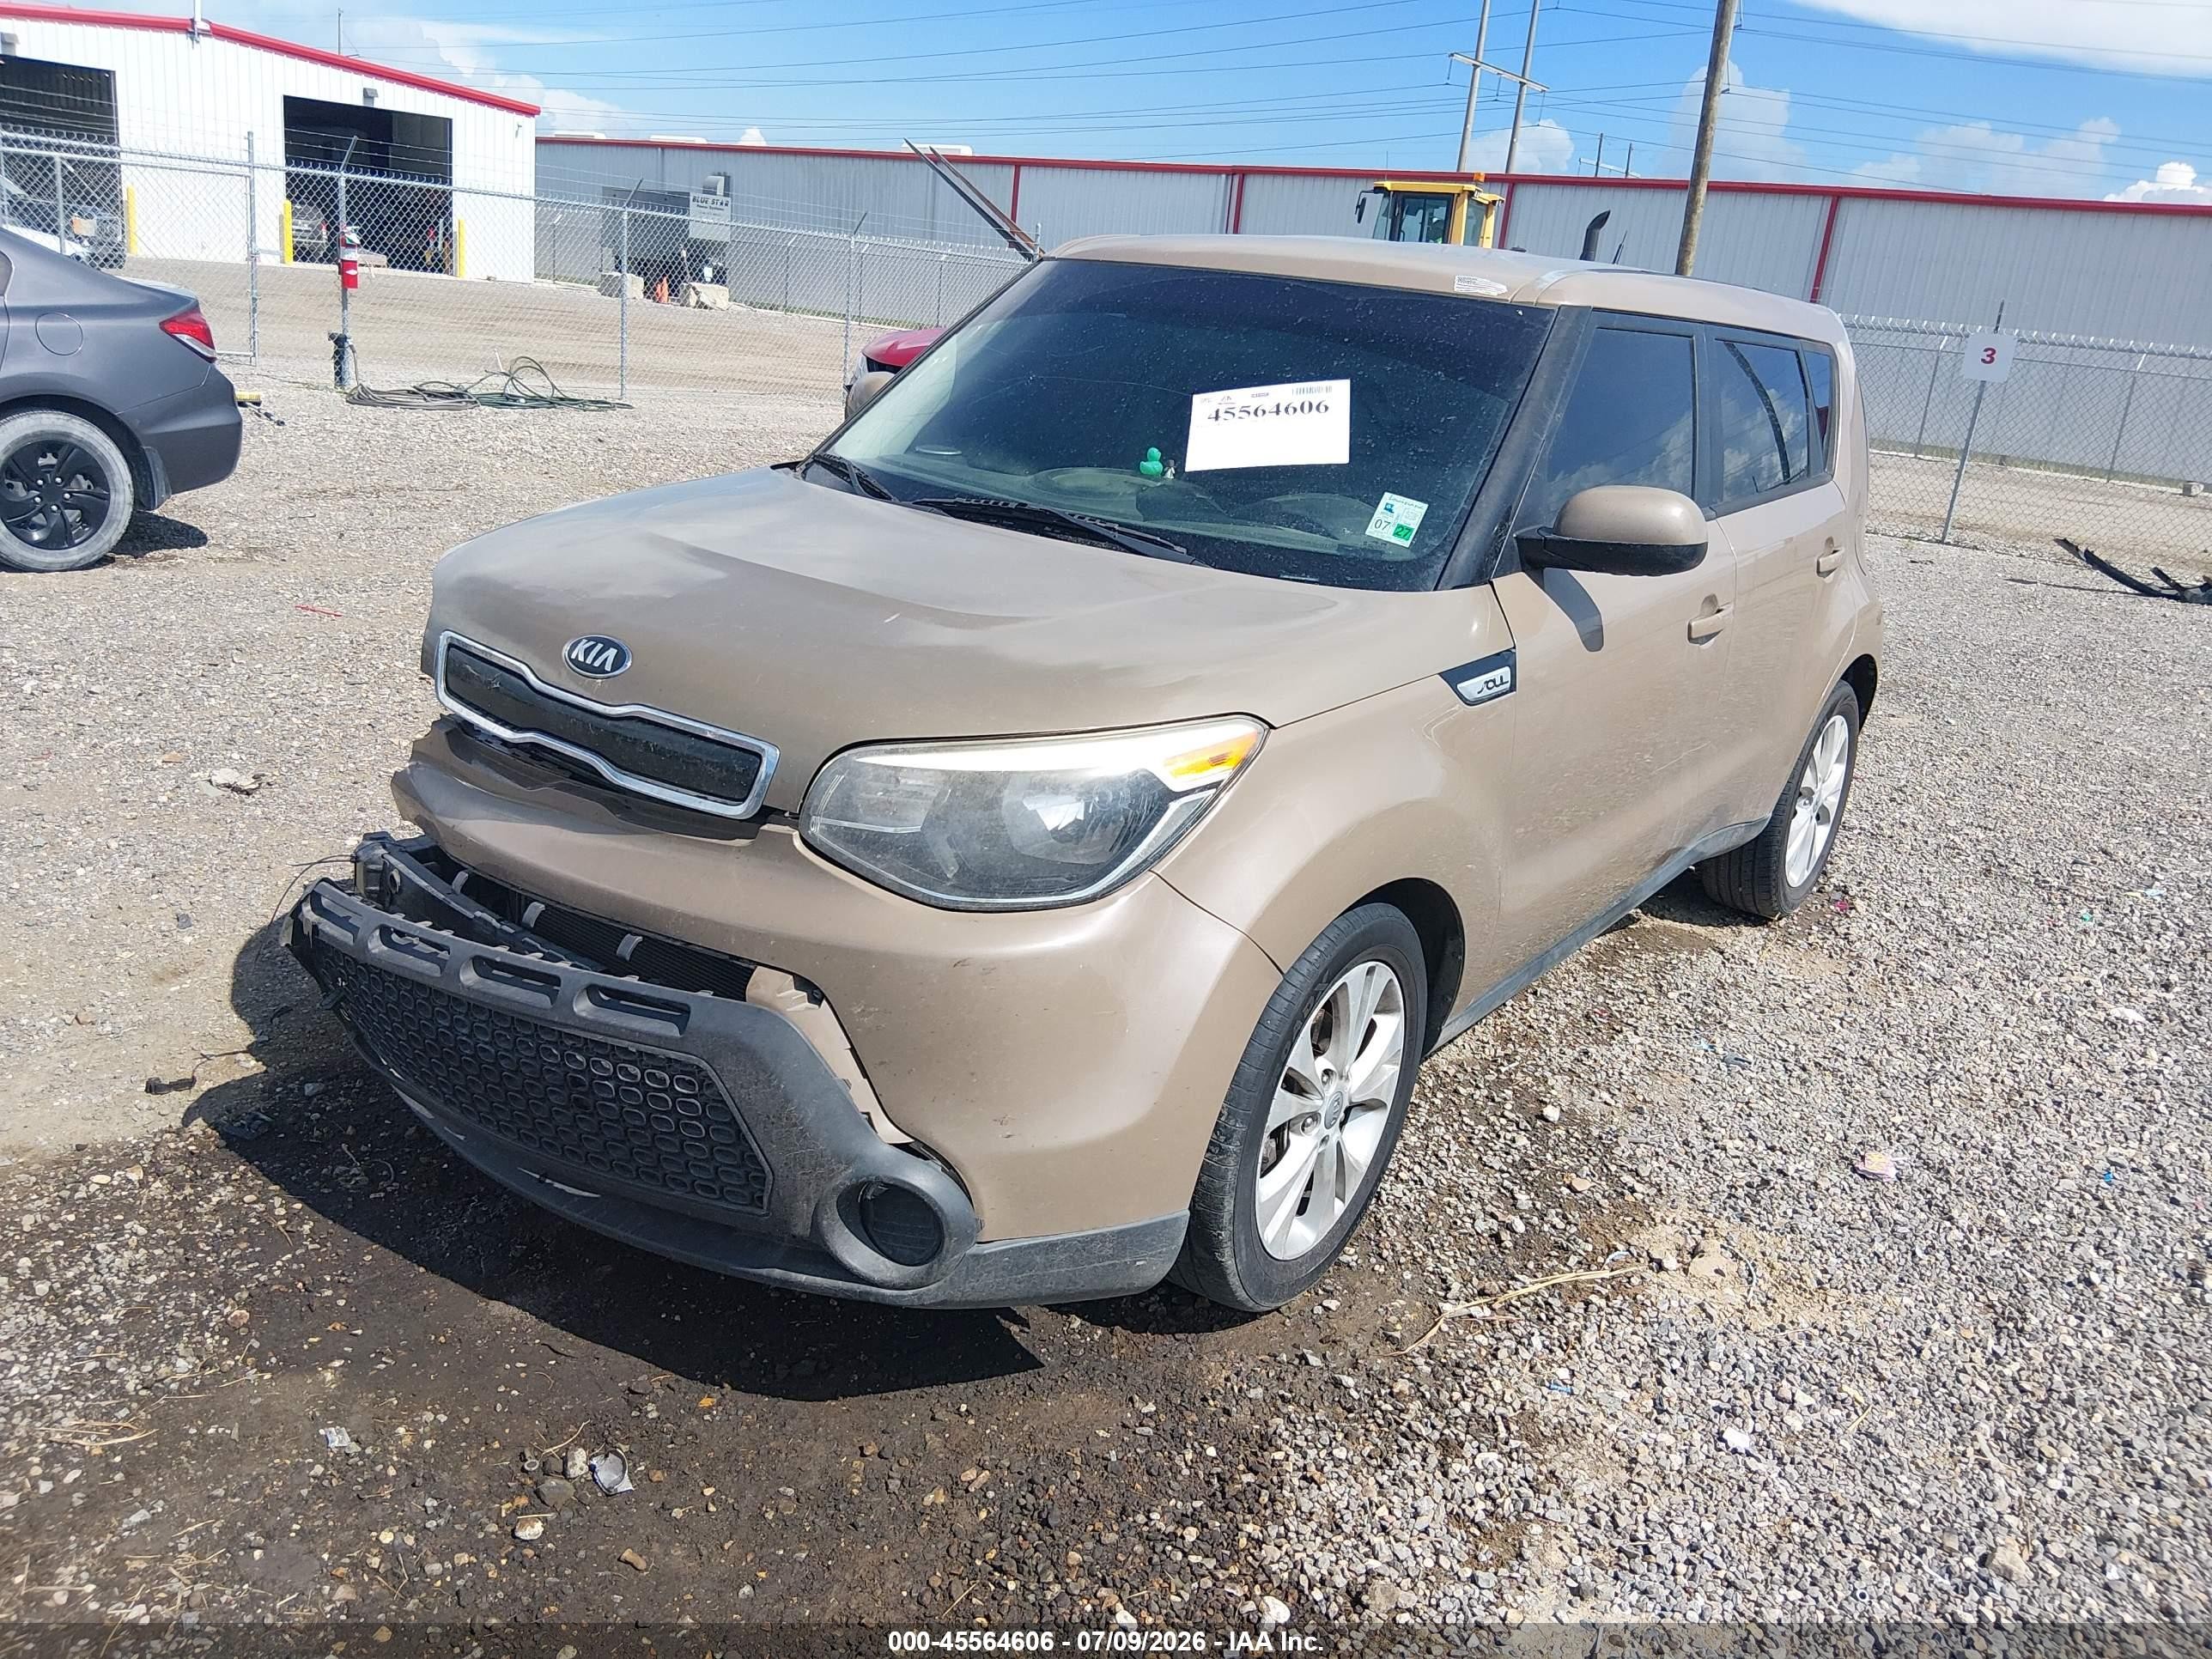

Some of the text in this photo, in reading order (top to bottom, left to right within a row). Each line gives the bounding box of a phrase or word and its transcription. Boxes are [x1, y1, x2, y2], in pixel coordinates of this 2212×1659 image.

[692, 196, 710, 204] BLUE
[1980, 347, 1996, 365] 3
[1207, 399, 1329, 422] 45564606
[1374, 519, 1391, 531] 07
[1395, 526, 1412, 538] 27
[570, 638, 618, 672] KIA
